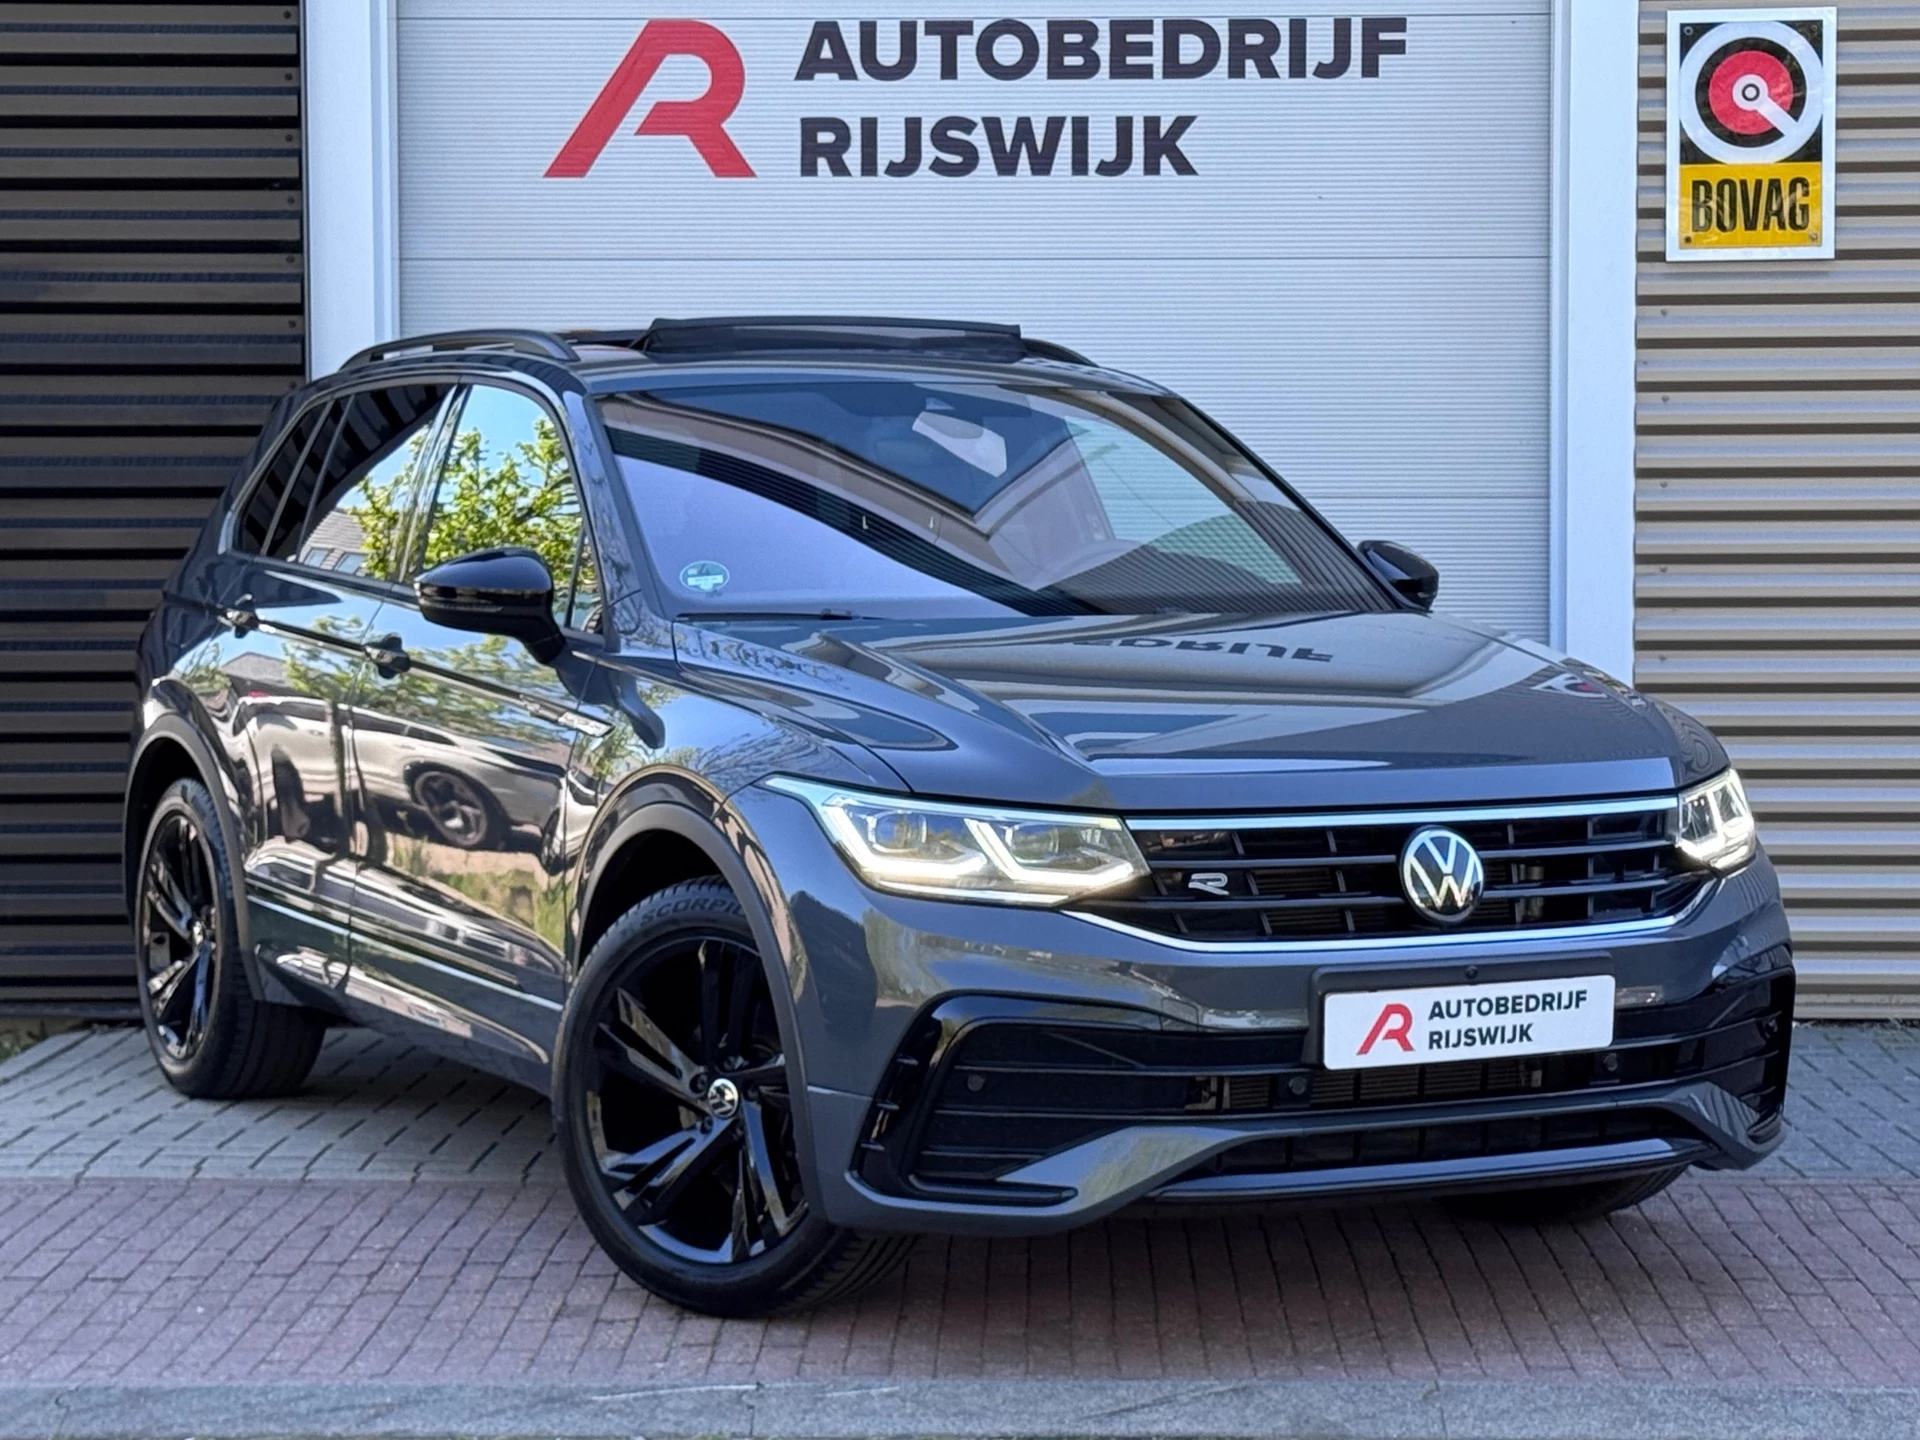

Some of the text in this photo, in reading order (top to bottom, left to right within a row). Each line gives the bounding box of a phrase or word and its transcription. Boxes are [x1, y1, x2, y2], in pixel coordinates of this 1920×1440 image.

[795, 17, 1408, 82] AUTOBEDRIJF
[800, 115, 1199, 178] RIJSWIJK
[1691, 176, 1810, 233] BOVAG
[1427, 988, 1588, 1021] AUTOBEDRIJF
[1428, 1022, 1534, 1051] RIJSWIJK
